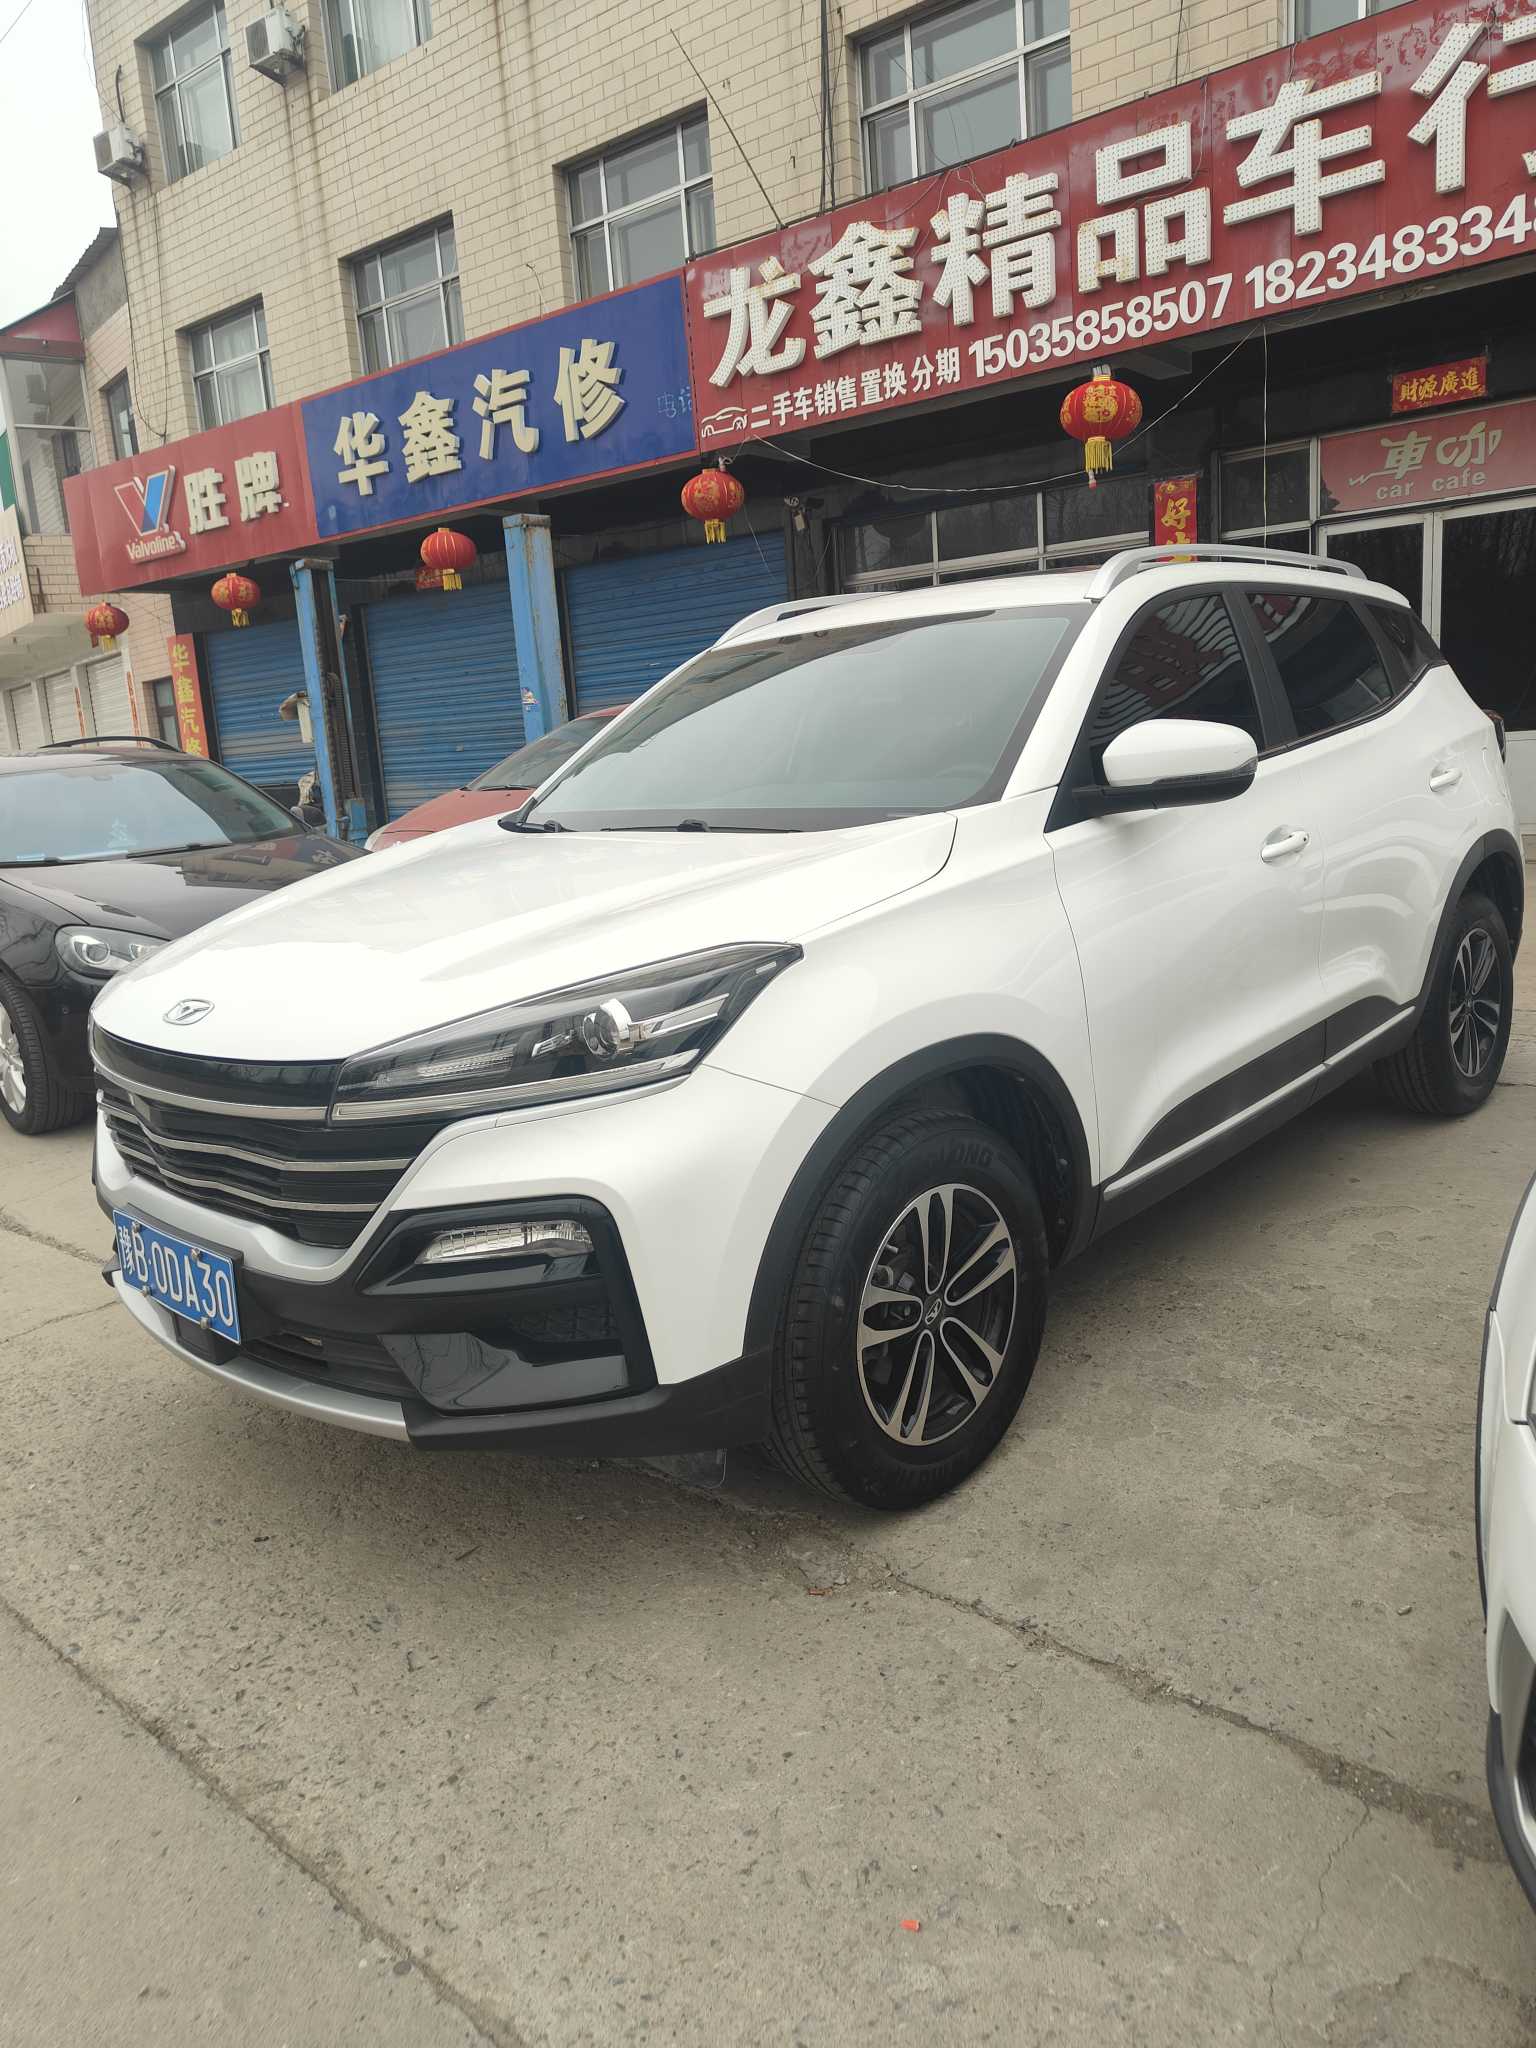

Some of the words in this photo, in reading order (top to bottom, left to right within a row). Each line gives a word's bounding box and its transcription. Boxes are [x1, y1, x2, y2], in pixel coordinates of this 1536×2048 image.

[968, 273, 1233, 378] 15035858507
[1245, 193, 1536, 310] 182348334
[333, 338, 626, 496] 华鑫汽修
[751, 347, 961, 429] 二手车销售置换分期
[183, 451, 283, 535] 胜牌
[1376, 481, 1414, 500] car
[1432, 469, 1487, 492] cafe
[126, 533, 183, 562] Valvoline
